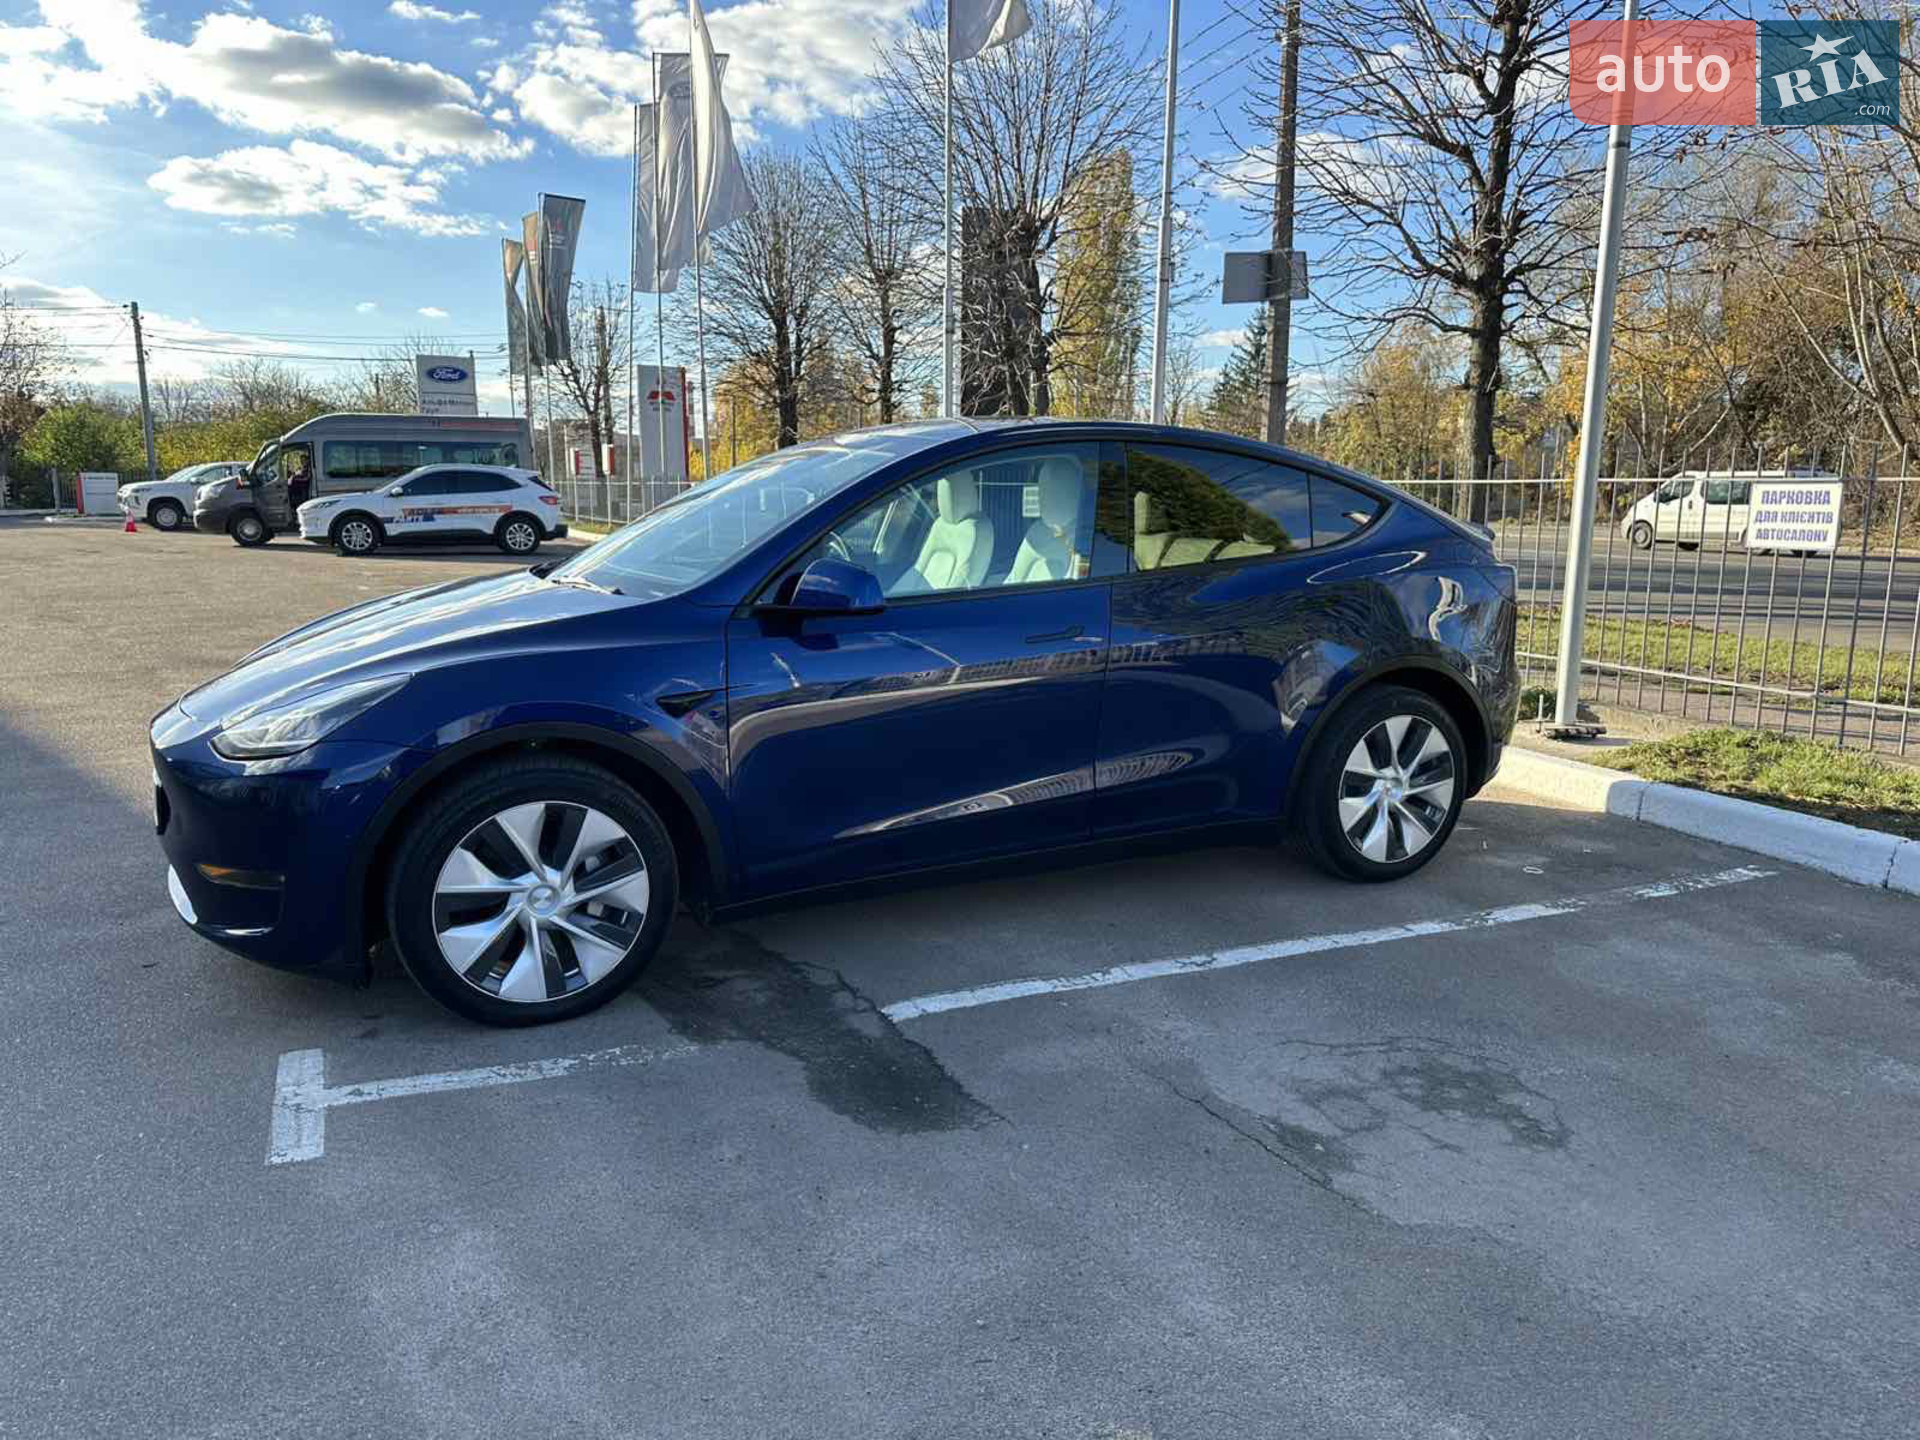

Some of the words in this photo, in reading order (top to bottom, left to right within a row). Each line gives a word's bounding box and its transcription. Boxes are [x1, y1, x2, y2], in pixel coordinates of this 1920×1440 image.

[432, 367, 461, 379] Ford
[1761, 490, 1831, 505] ПАРКОВКА
[1755, 510, 1778, 523] ДЛЯ
[1780, 511, 1834, 524] КЛІЄНТІВ
[1755, 528, 1829, 542] АВТОСАЛОНУ
